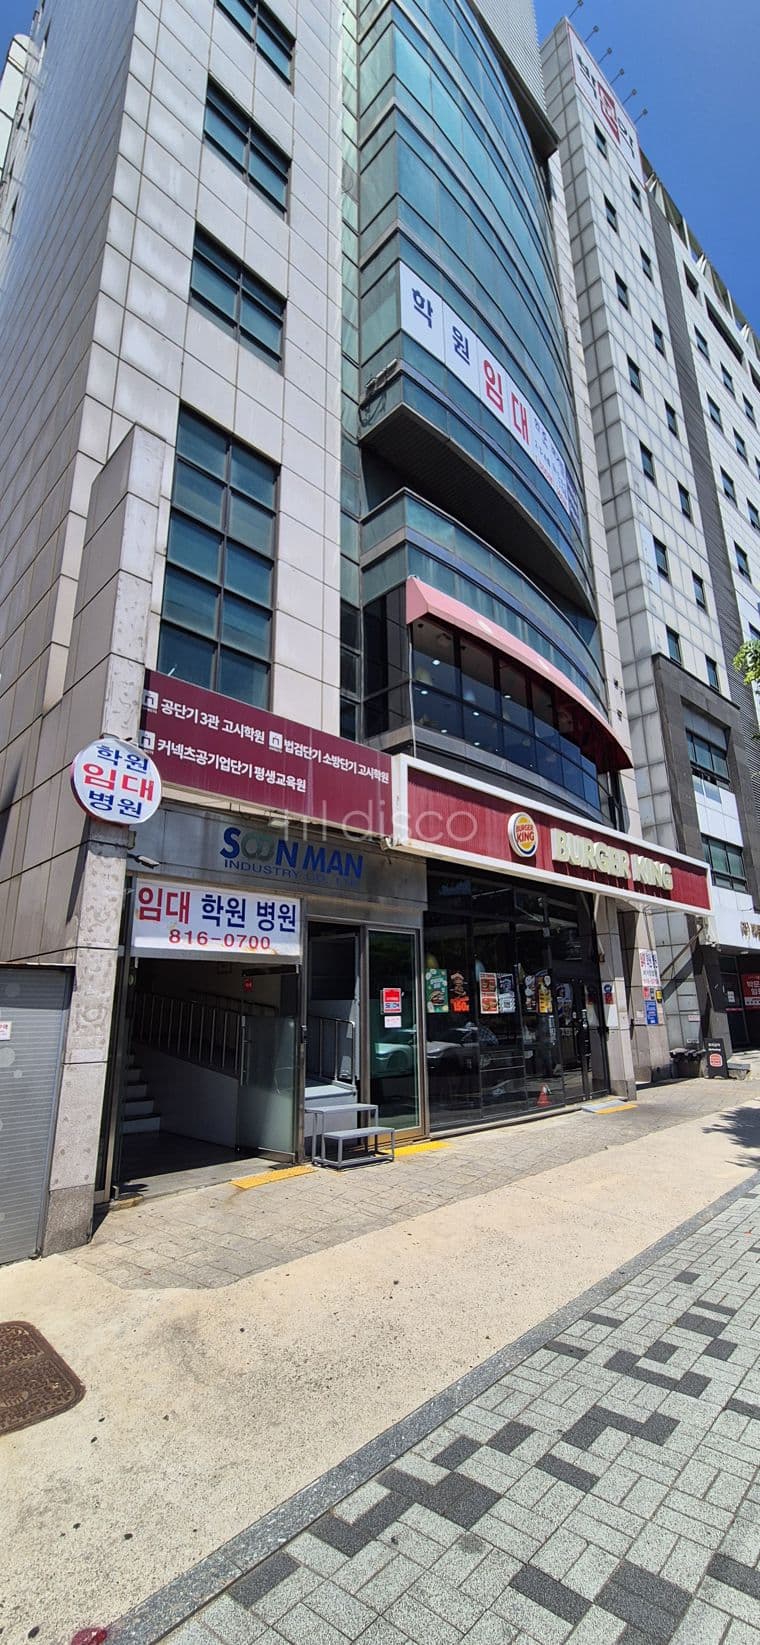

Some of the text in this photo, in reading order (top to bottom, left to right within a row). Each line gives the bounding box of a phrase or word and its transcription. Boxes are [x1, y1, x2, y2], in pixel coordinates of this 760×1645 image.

[411, 287, 530, 445] 학원 임대
[96, 744, 150, 775] 학원
[160, 699, 390, 785] 공단기 3관 고시학원 법검단기 소방단기 고시학원
[82, 763, 155, 802] 임대
[157, 738, 307, 793] 커넥츠공기업단기 평생교육원
[88, 790, 143, 819] 병원
[516, 824, 534, 833] BURGER
[517, 830, 535, 843] KING
[224, 859, 301, 879] INDUSTRY
[302, 844, 364, 880] MAN
[550, 827, 674, 891] BURGER KING
[138, 887, 296, 933] 임대 학원 병원
[168, 928, 271, 950] 816-0700
